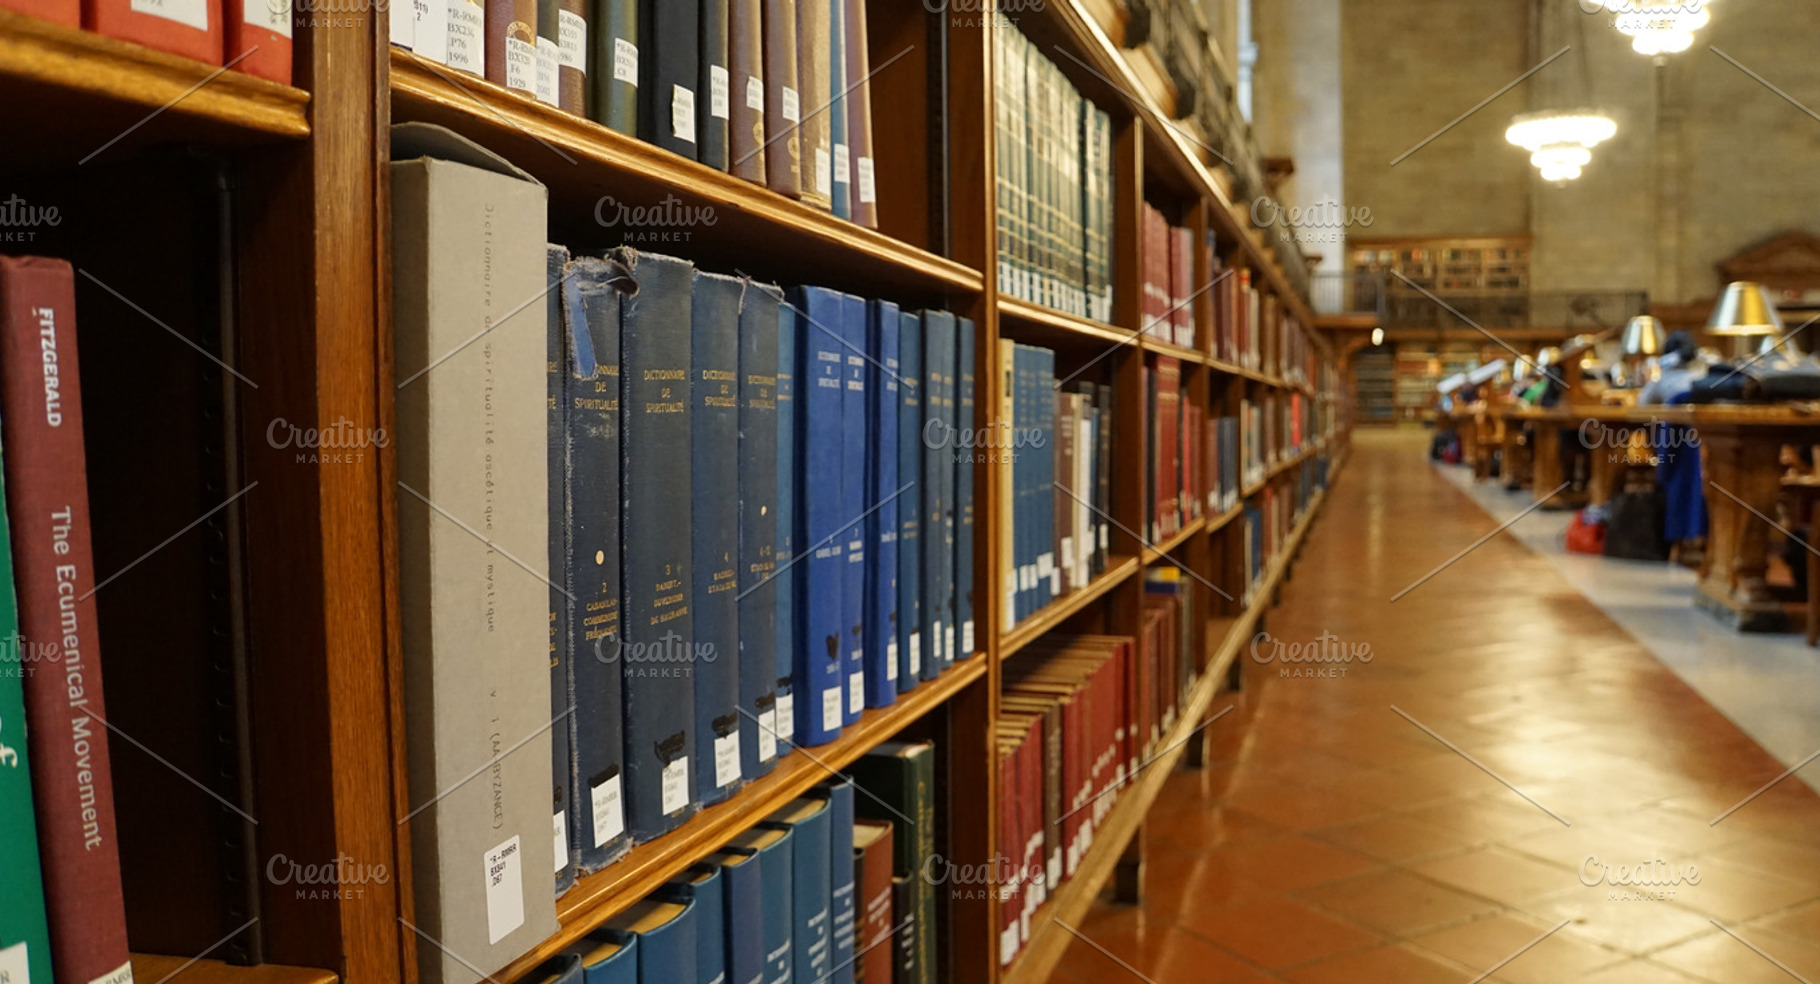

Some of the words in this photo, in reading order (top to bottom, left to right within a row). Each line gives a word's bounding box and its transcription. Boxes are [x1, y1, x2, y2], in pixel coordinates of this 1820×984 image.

[416, 12, 422, 21] 2
[449, 52, 469, 64] 1996
[484, 202, 494, 306] Dictionnaire
[39, 308, 62, 427] FITZGERALD
[484, 343, 494, 445] spiritualité
[594, 381, 607, 392] DE
[661, 387, 672, 398] DE
[485, 454, 494, 532] ascétique
[52, 505, 72, 555] The
[486, 564, 494, 632] mystique
[602, 582, 607, 593] 2
[665, 564, 672, 576] 3
[56, 564, 88, 708] Ecumenical
[72, 717, 103, 852] Movement
